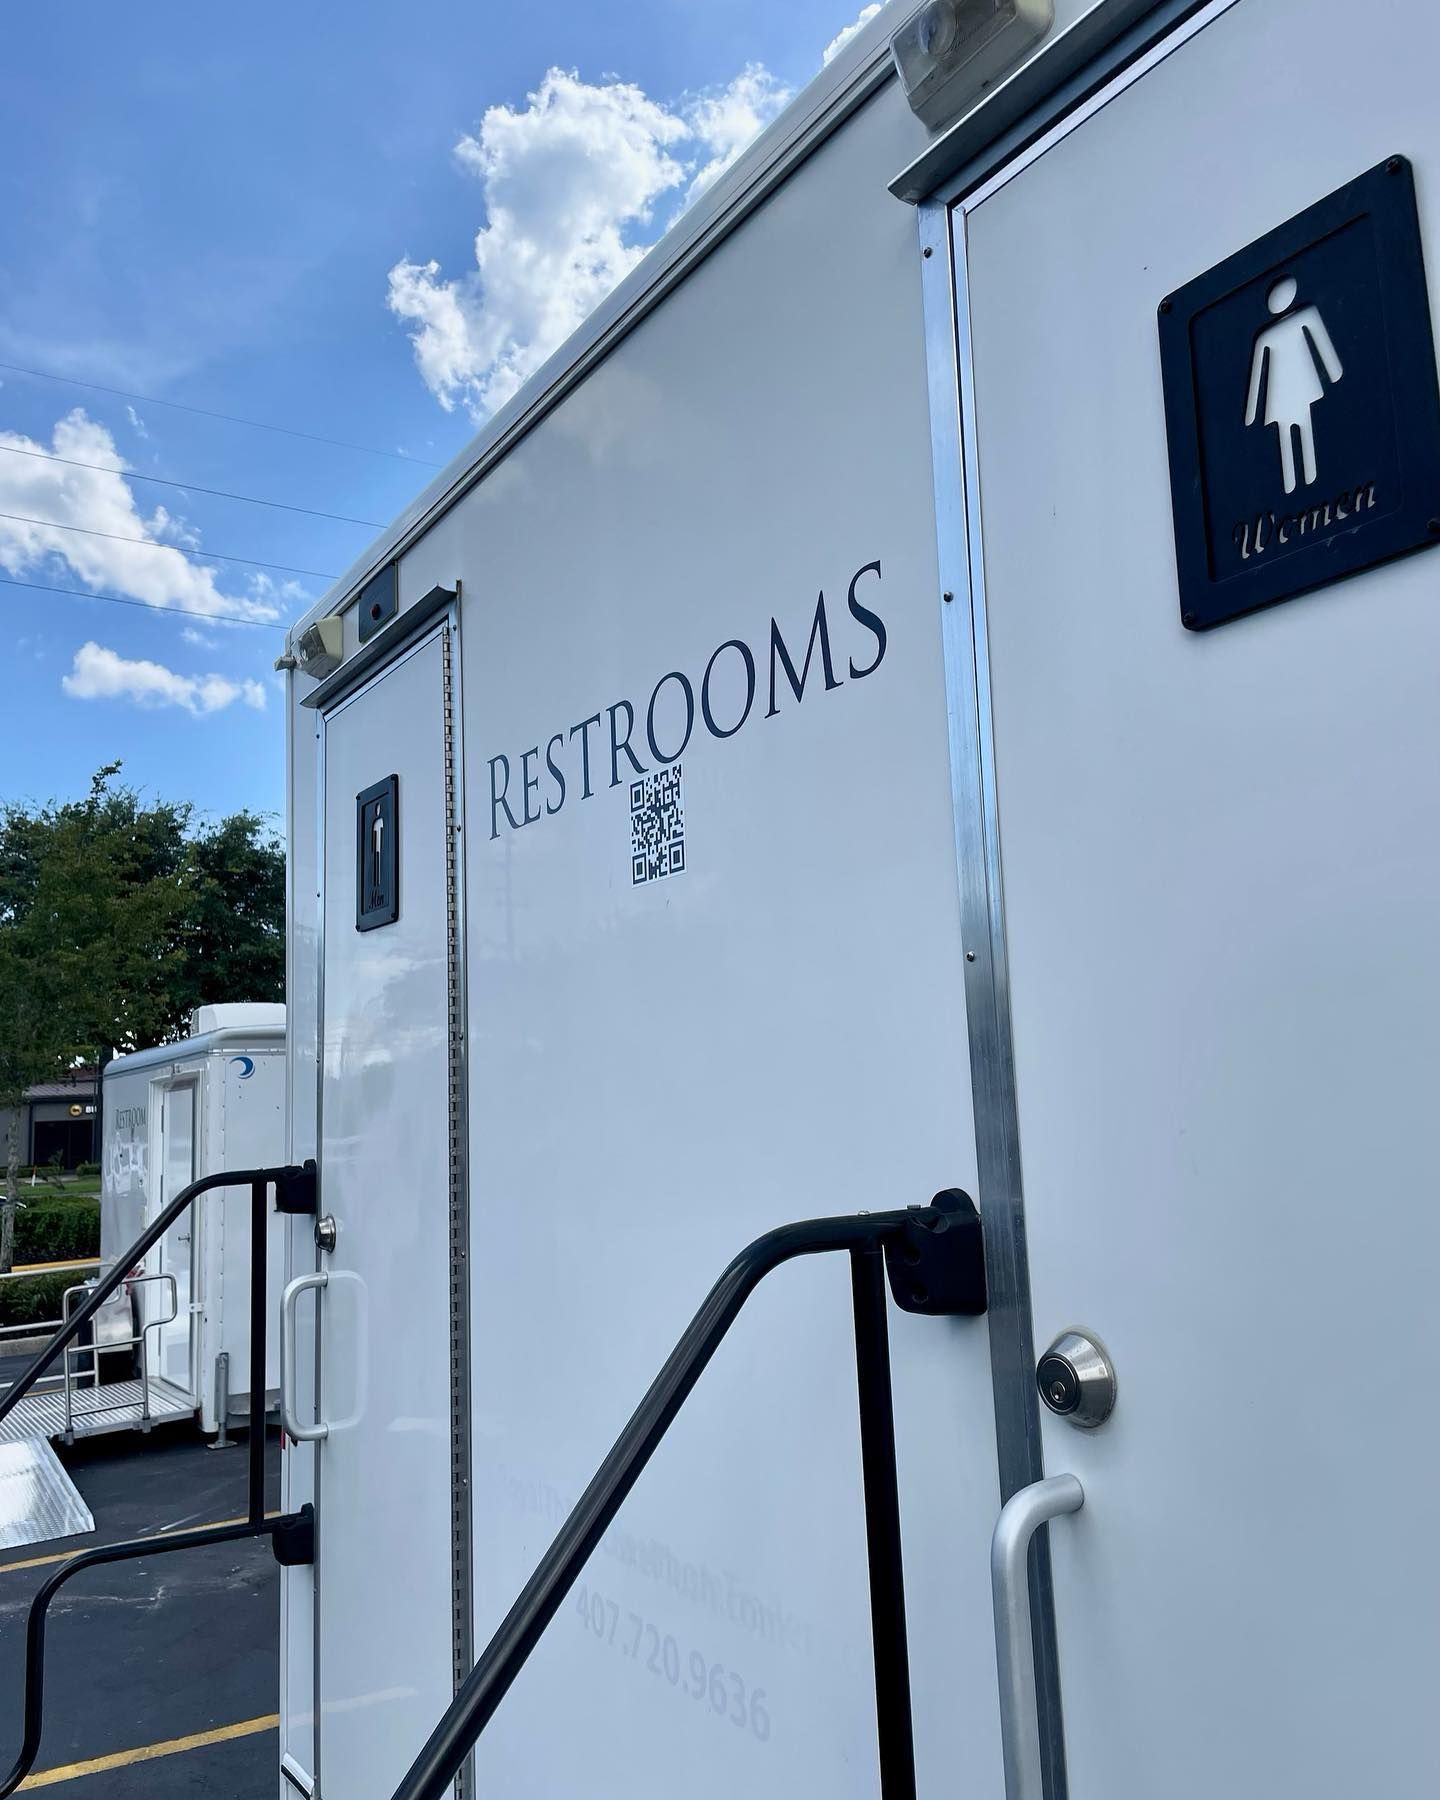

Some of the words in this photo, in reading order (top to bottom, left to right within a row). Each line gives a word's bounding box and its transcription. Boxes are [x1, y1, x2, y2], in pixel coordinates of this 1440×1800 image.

[1232, 482, 1376, 559] Women
[487, 560, 887, 840] RESTROOMS
[367, 890, 385, 909] Men
[575, 1584, 771, 1742] 407.720.9636
